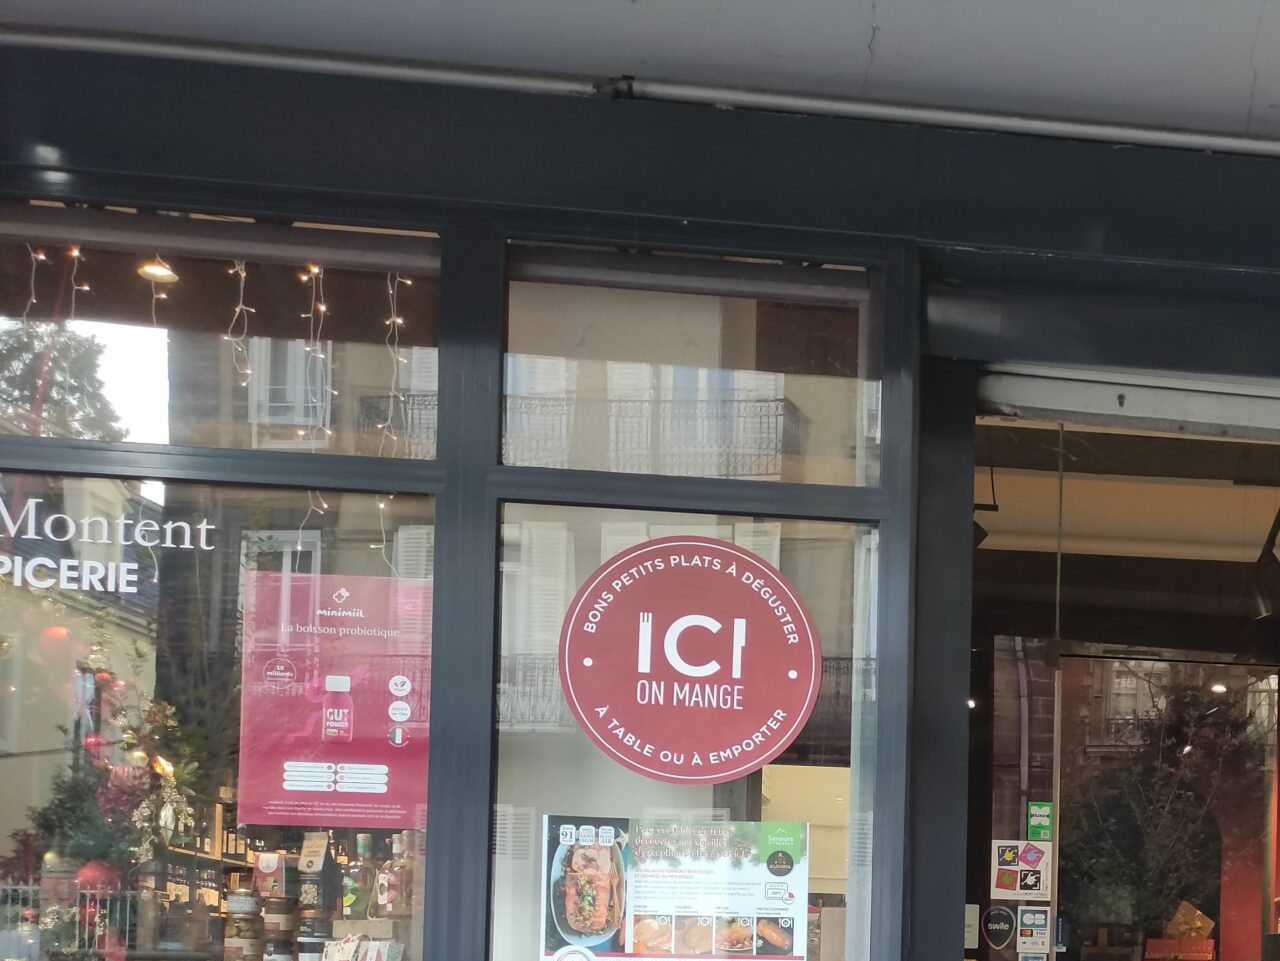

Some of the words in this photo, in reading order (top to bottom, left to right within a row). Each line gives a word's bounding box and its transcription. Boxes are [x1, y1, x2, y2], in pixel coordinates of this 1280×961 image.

[0, 497, 215, 550] Montent
[584, 591, 614, 633] BONS
[612, 557, 665, 593] PETITS
[670, 555, 722, 570] PLATS
[725, 561, 737, 577] À
[741, 571, 799, 645] DÉGUSTER
[281, 623, 293, 632] La
[296, 623, 336, 634] boisson
[339, 626, 400, 639] probiotique
[638, 612, 747, 679] ICI
[636, 680, 665, 705] ON
[673, 682, 744, 710] MANGE
[326, 708, 349, 721] GUT
[594, 704, 609, 718] À
[607, 718, 655, 757] TABLE
[659, 750, 685, 765] OU
[691, 751, 703, 766] À
[709, 708, 788, 764] EMPORTER
[561, 830, 574, 840] 91
[988, 922, 1009, 930] swile
[1022, 913, 1046, 925] CB
